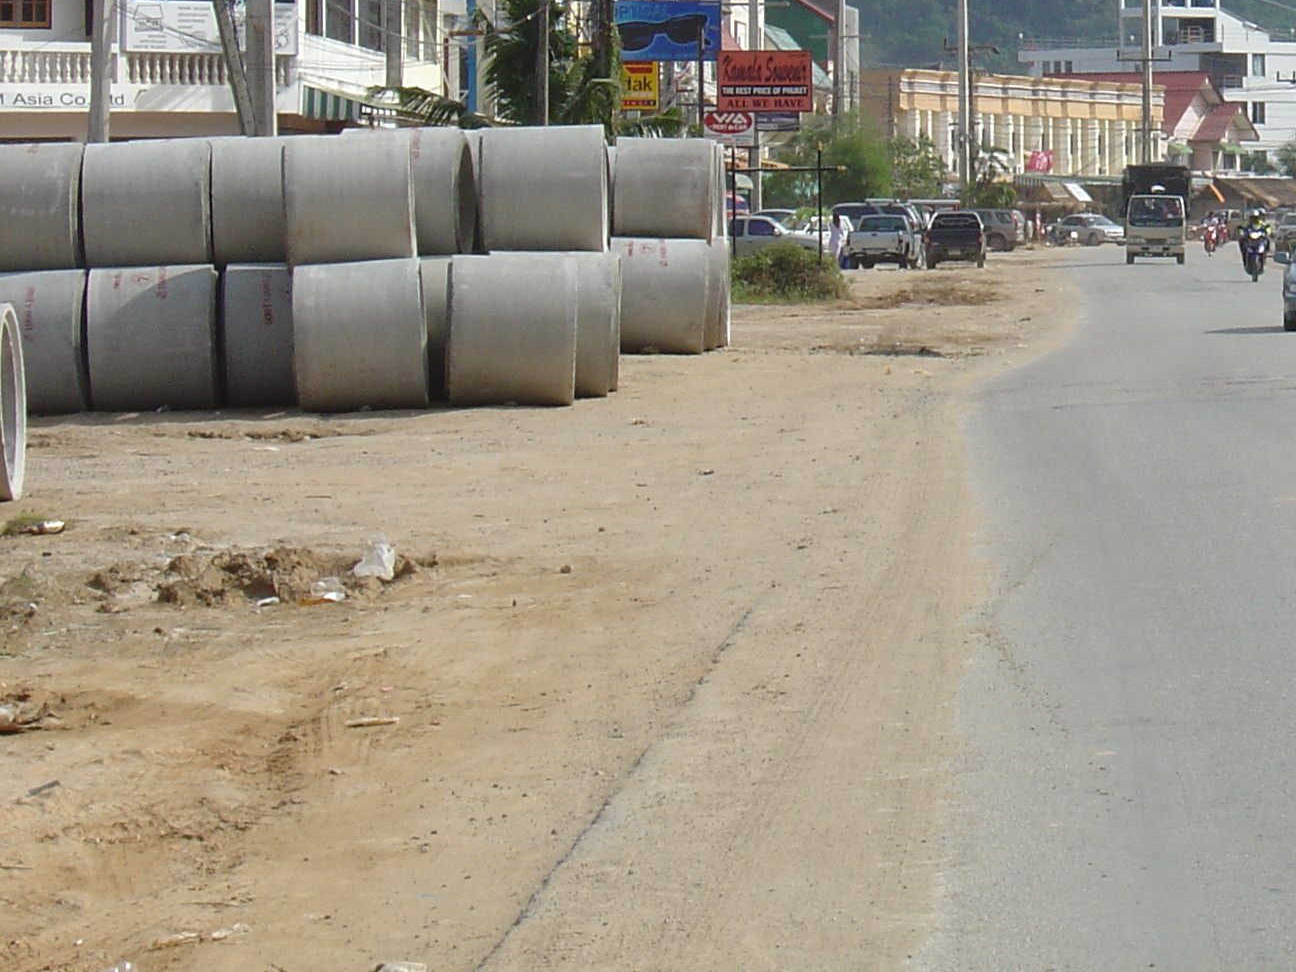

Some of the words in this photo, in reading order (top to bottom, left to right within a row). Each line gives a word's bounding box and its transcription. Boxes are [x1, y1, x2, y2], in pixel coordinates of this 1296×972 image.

[723, 86, 734, 95] THE
[736, 86, 751, 95] BEST
[753, 86, 771, 95] PRICE
[773, 86, 781, 95] OF
[782, 86, 807, 95] PHUKET
[13, 93, 53, 106] Asia
[109, 94, 125, 105] td
[727, 99, 748, 108] ALL
[752, 99, 770, 108] WE
[774, 99, 804, 108] HAVE
